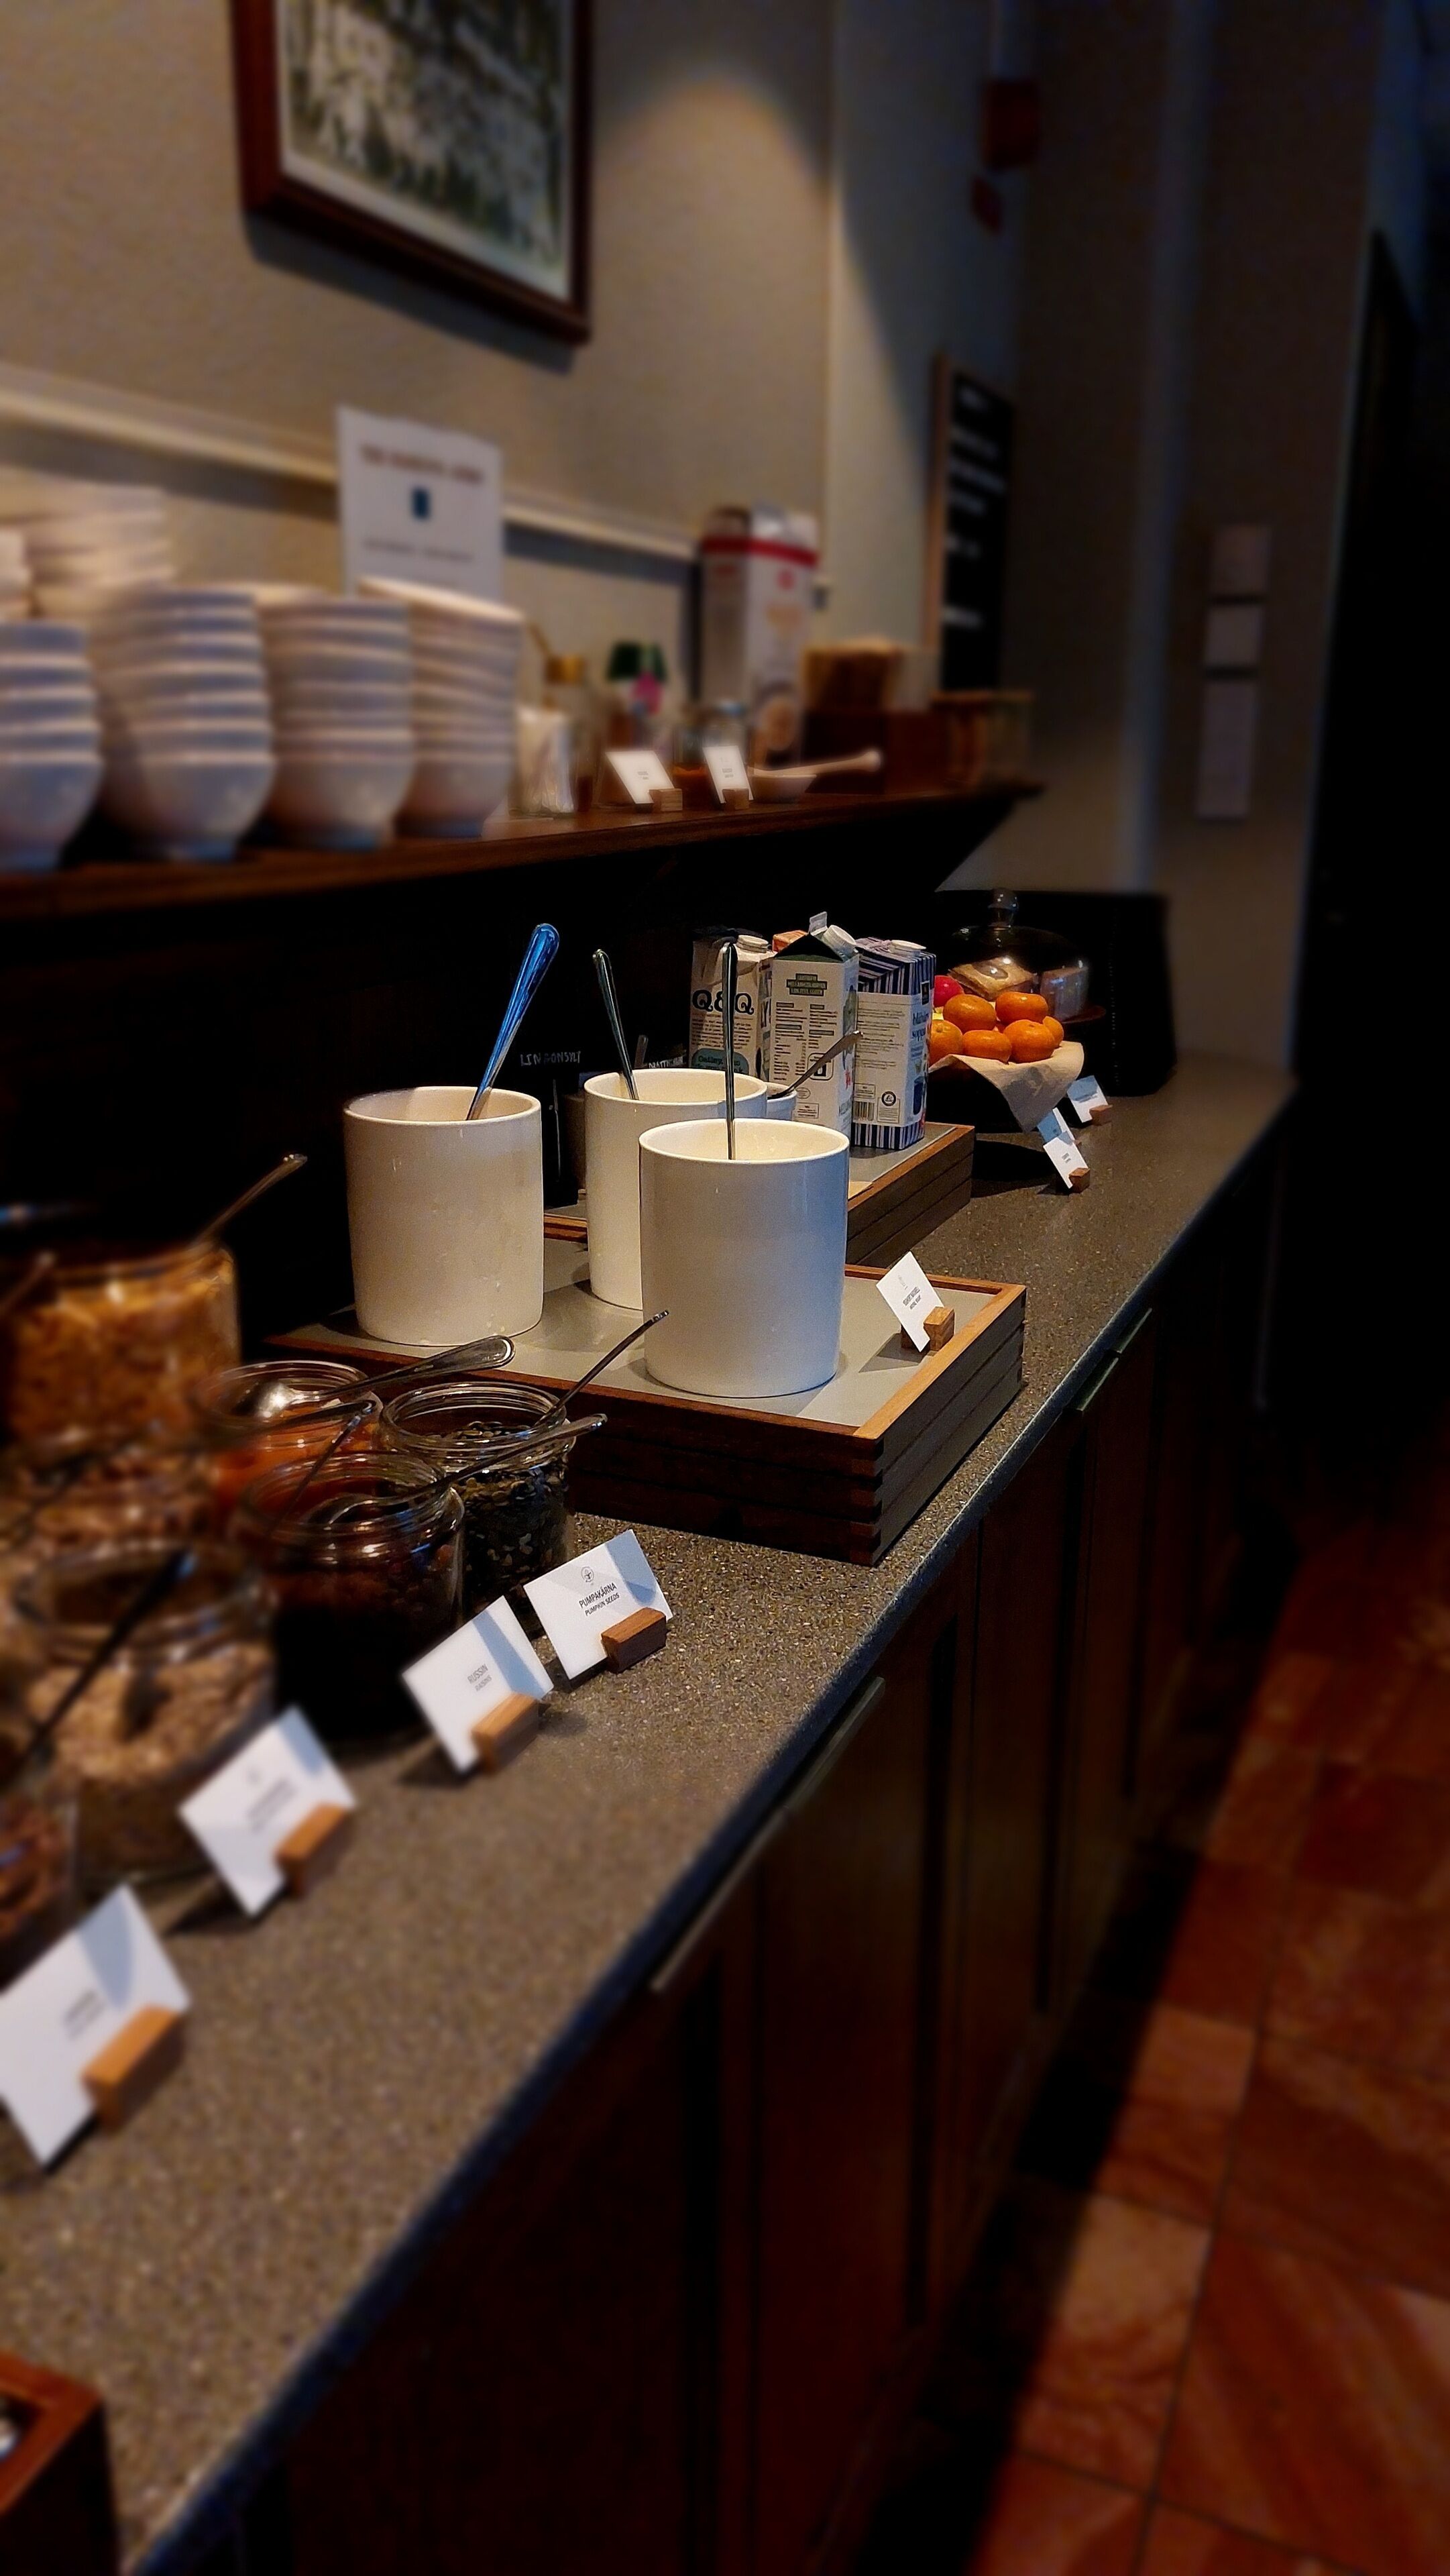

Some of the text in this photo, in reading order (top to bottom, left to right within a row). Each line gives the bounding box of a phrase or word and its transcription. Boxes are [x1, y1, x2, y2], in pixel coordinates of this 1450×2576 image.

[585, 1592, 620, 1617] PUMPKIN SEEDS
[467, 1663, 489, 1684] RUSSIN
